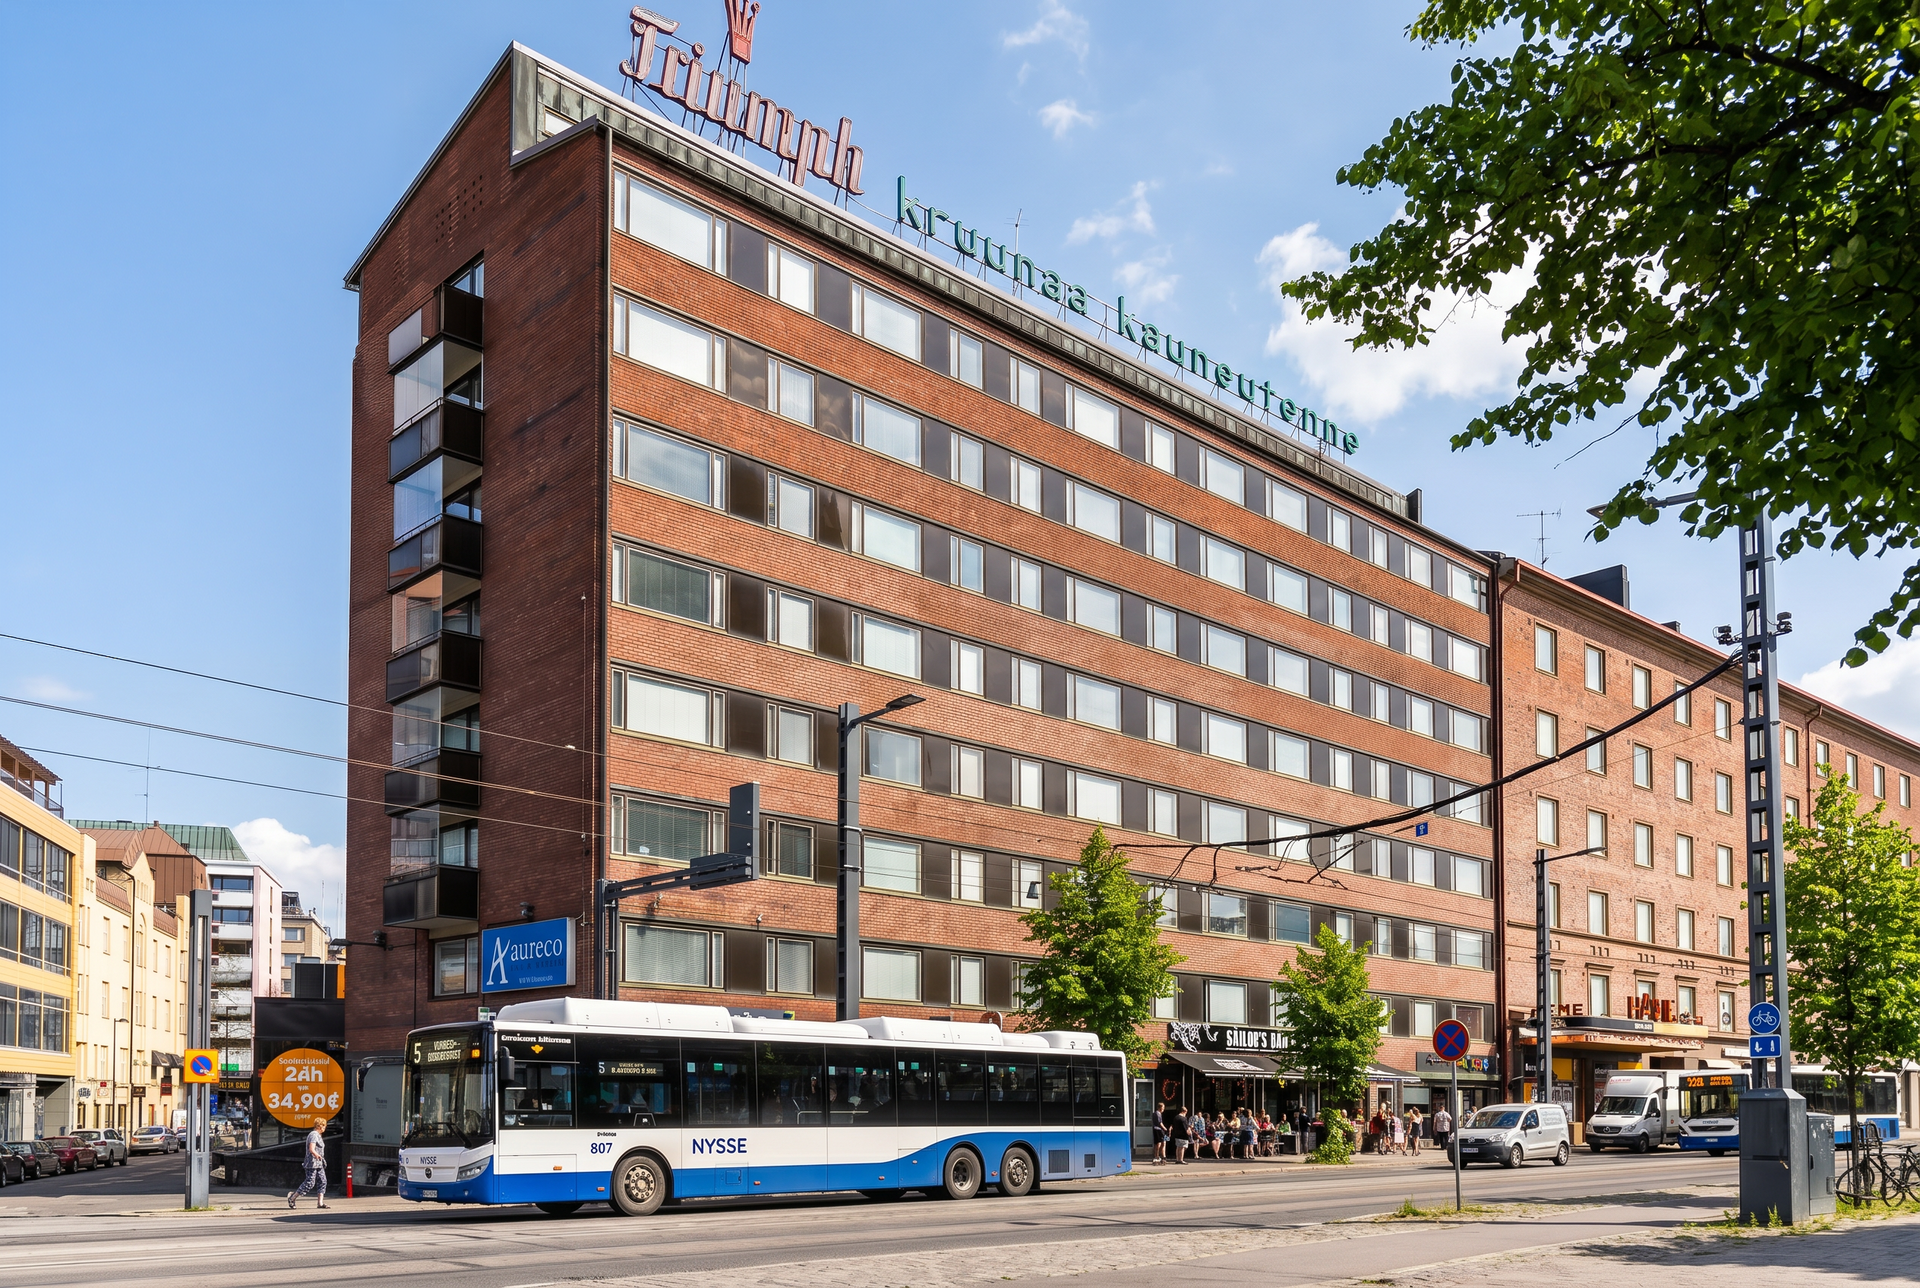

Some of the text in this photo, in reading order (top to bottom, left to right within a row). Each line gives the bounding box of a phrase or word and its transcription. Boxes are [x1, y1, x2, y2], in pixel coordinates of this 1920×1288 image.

[618, 5, 865, 195] Triumph
[897, 175, 1360, 455] kruunaa kauneutenne
[413, 1042, 422, 1063] 5
[598, 1061, 606, 1074] 5
[590, 1142, 613, 1154] 807
[692, 1138, 748, 1155] NYSSE
[420, 1156, 437, 1165] NYSSE
